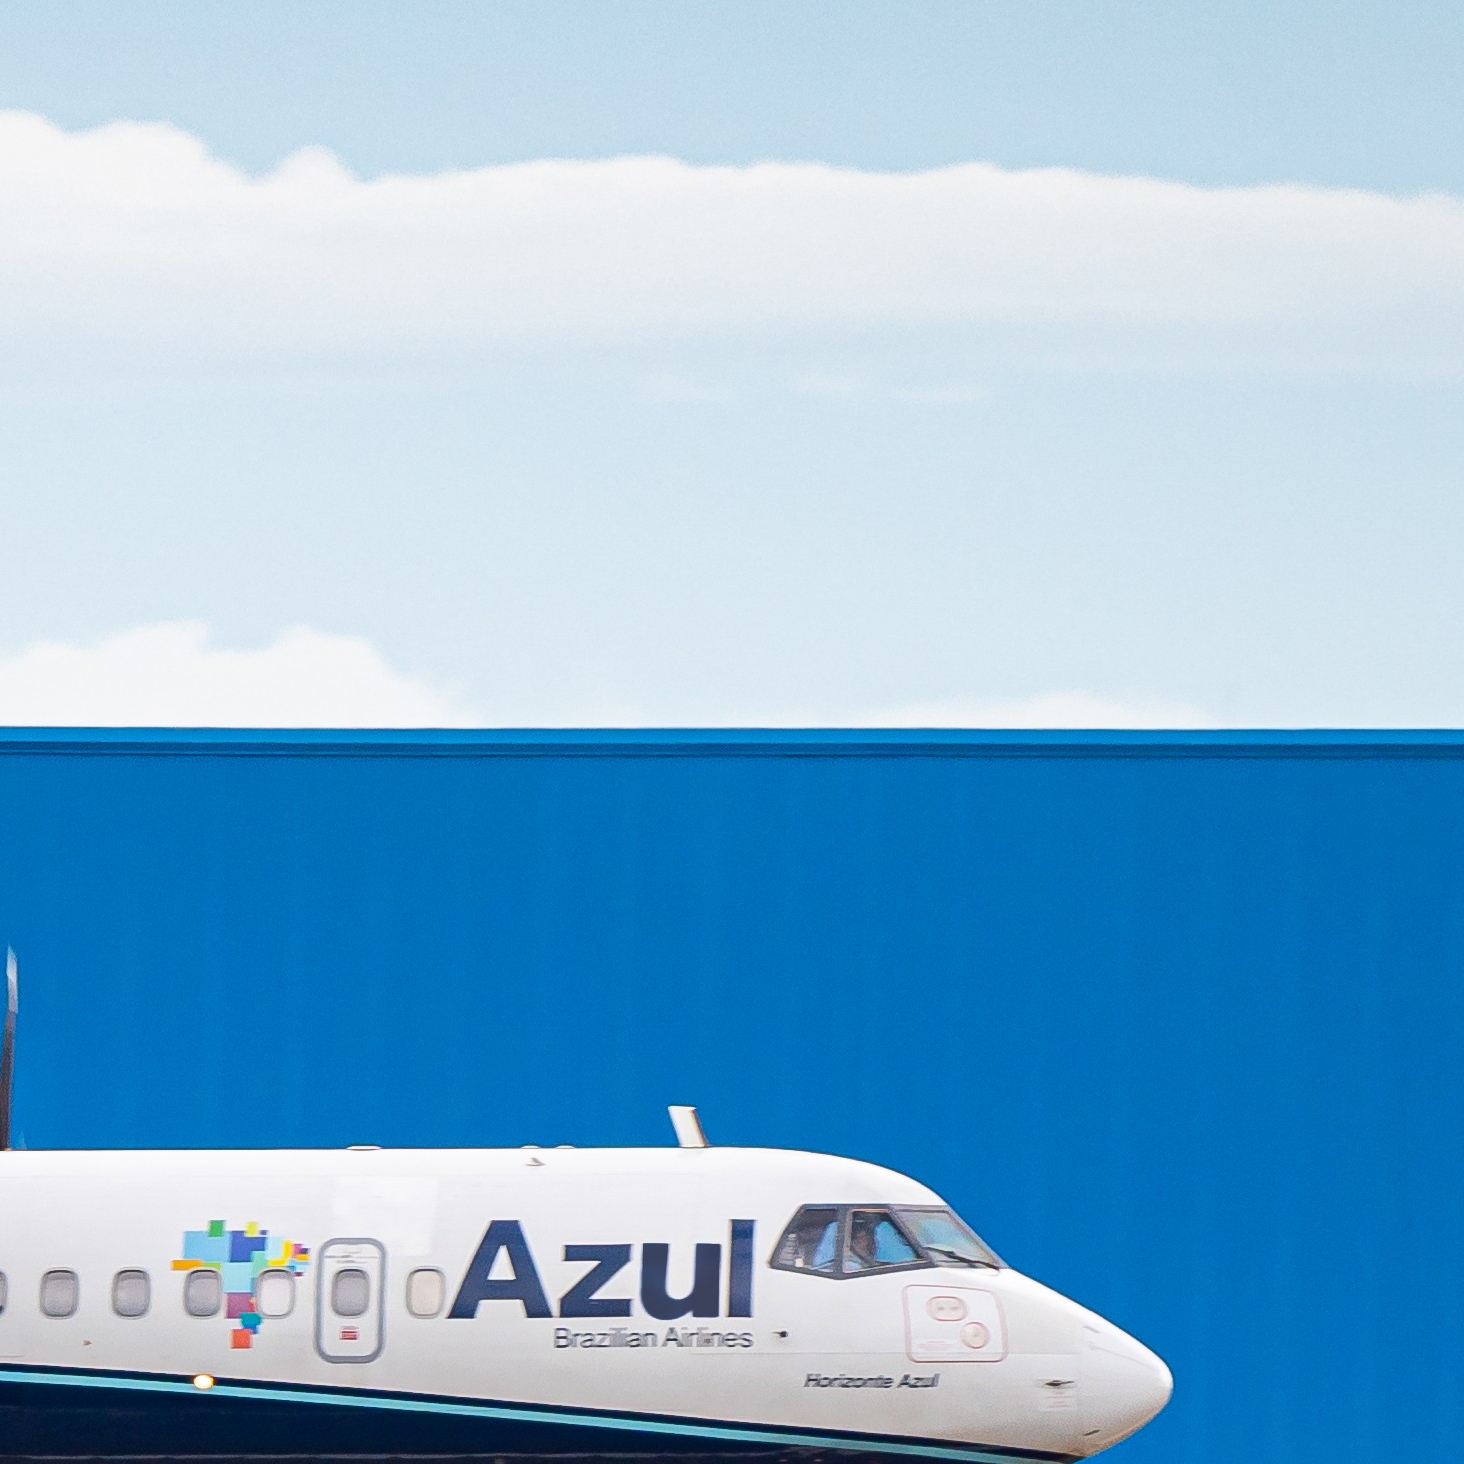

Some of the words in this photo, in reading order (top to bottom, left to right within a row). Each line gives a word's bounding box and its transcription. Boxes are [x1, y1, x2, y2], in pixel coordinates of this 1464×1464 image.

[446, 1219, 757, 1320] Azul
[553, 1327, 658, 1348] Brazilian
[662, 1327, 754, 1348] Airlines
[804, 1373, 893, 1388] Horizonte
[895, 1373, 940, 1388] Azul
